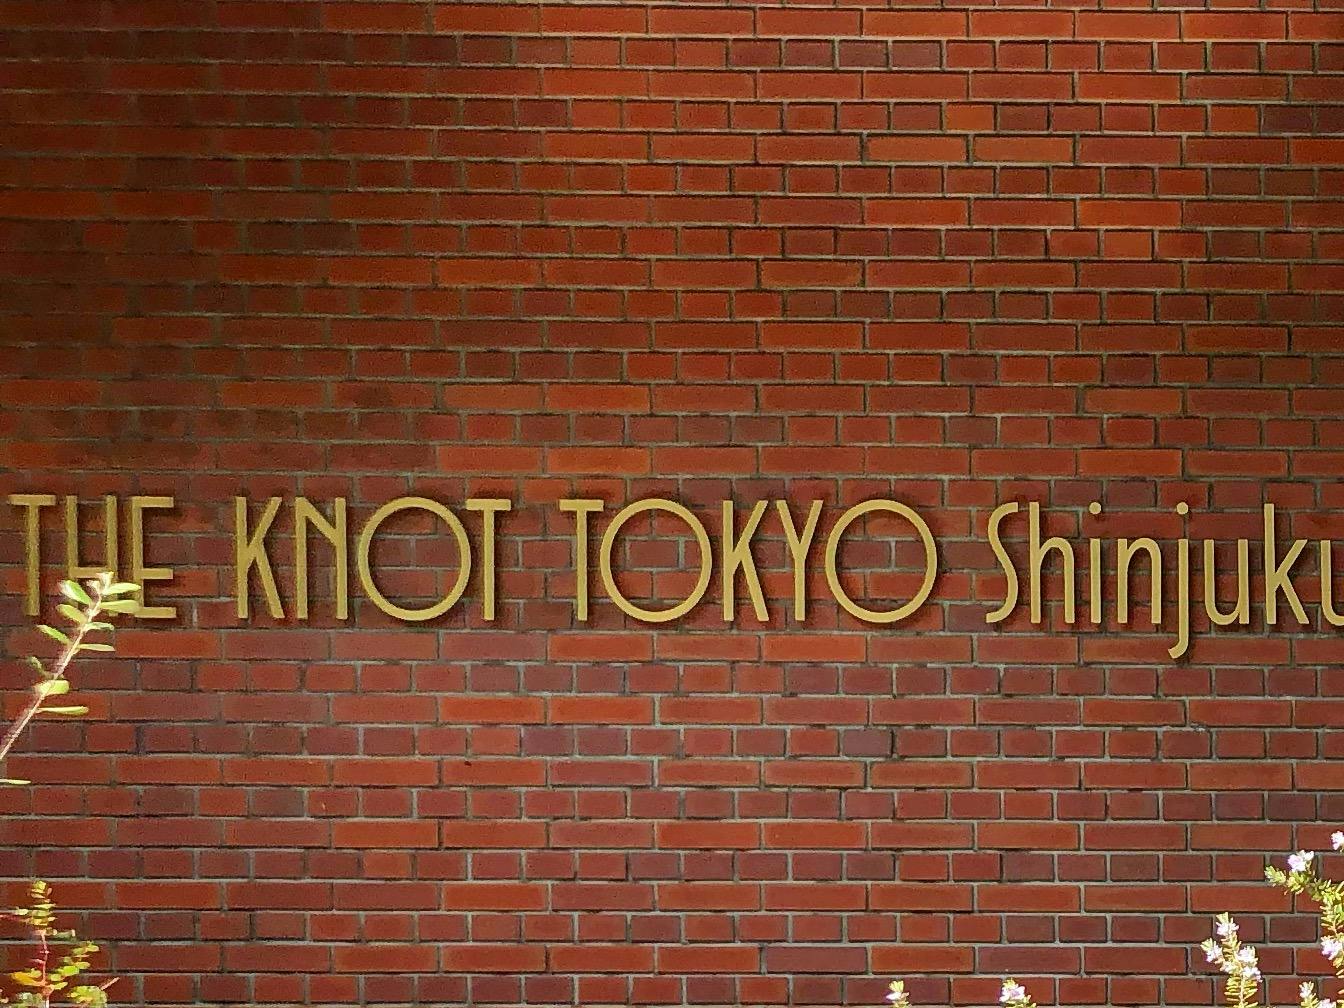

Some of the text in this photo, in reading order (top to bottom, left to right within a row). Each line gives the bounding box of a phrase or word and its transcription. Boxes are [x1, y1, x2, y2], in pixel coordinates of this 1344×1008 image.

[8, 494, 177, 619] THE
[236, 496, 511, 622] KNOT
[560, 498, 938, 623] TOKYO
